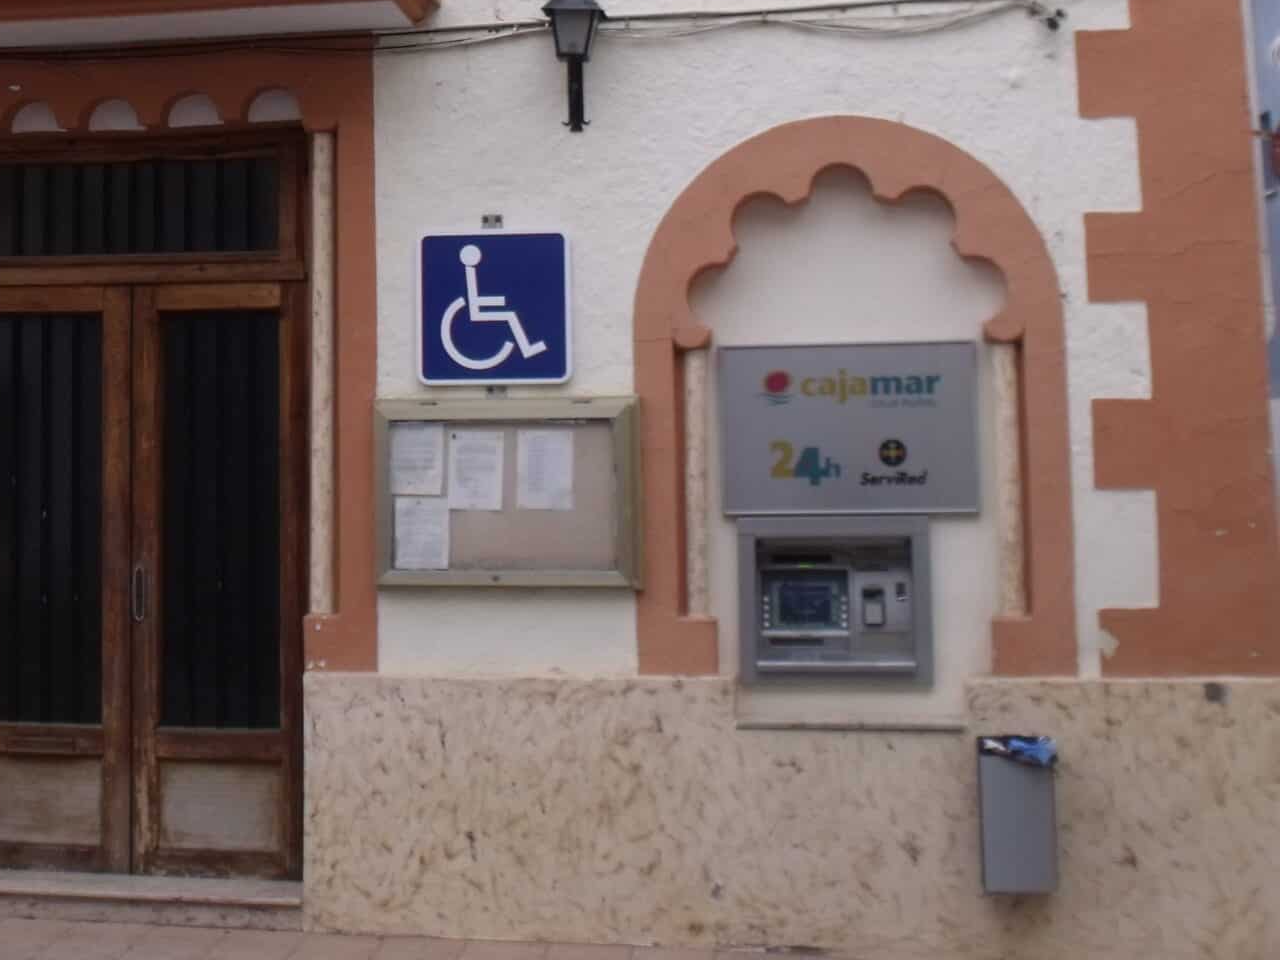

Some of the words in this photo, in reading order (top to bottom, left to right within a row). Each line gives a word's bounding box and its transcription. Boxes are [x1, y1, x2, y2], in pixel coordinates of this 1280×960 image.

[800, 369, 941, 404] cajamar
[770, 440, 842, 486] 24h
[860, 470, 928, 486] ServiRed
